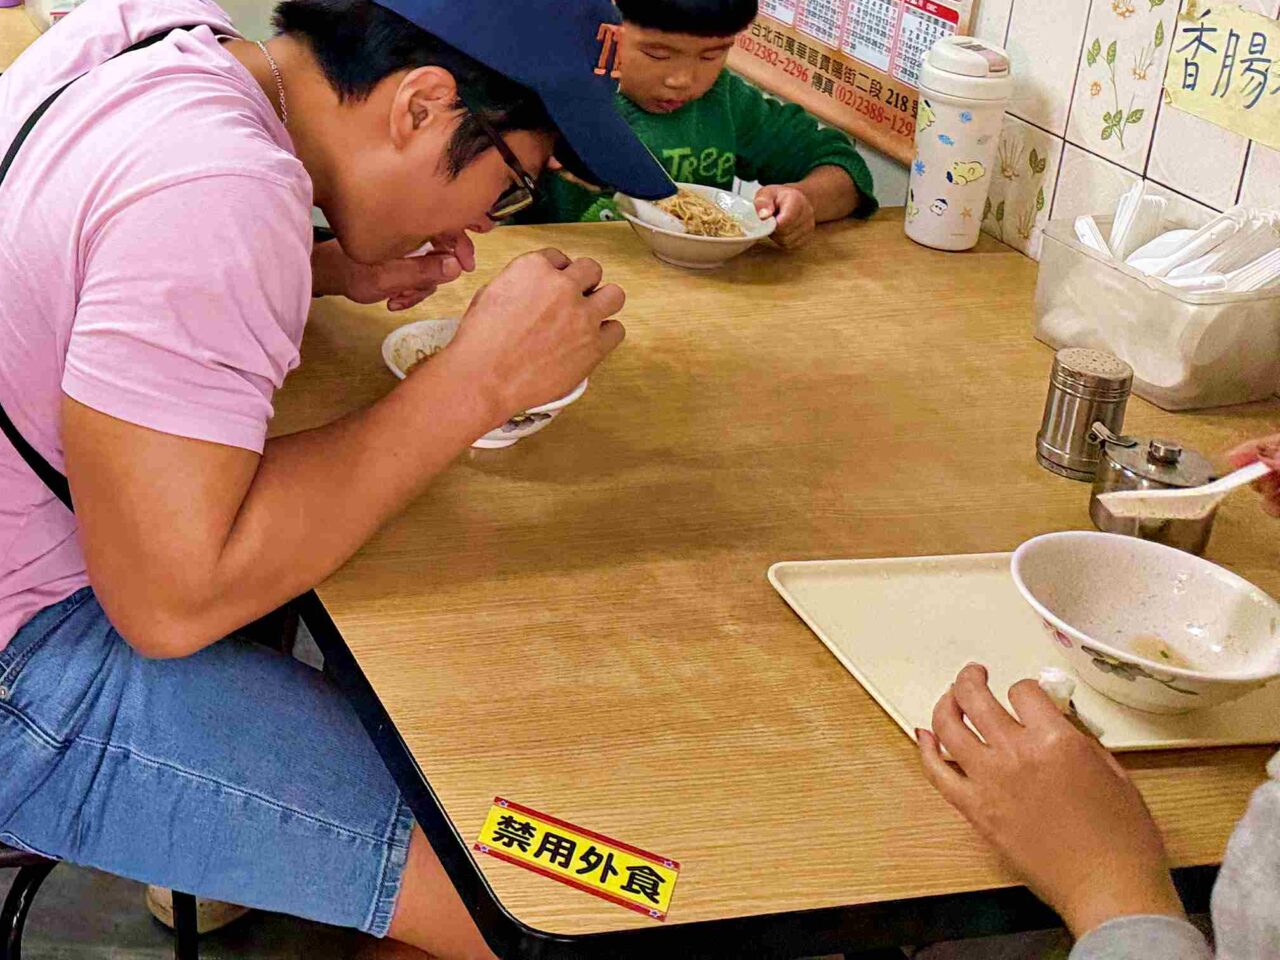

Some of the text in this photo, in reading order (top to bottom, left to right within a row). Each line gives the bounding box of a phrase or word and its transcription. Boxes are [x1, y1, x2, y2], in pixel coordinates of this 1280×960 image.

[736, 34, 809, 82] (02)2382-2296
[835, 84, 916, 137] (02)2388-129
[886, 89, 908, 113] 218
[1176, 8, 1280, 110] 香腸
[492, 815, 666, 904] 禁用外食
